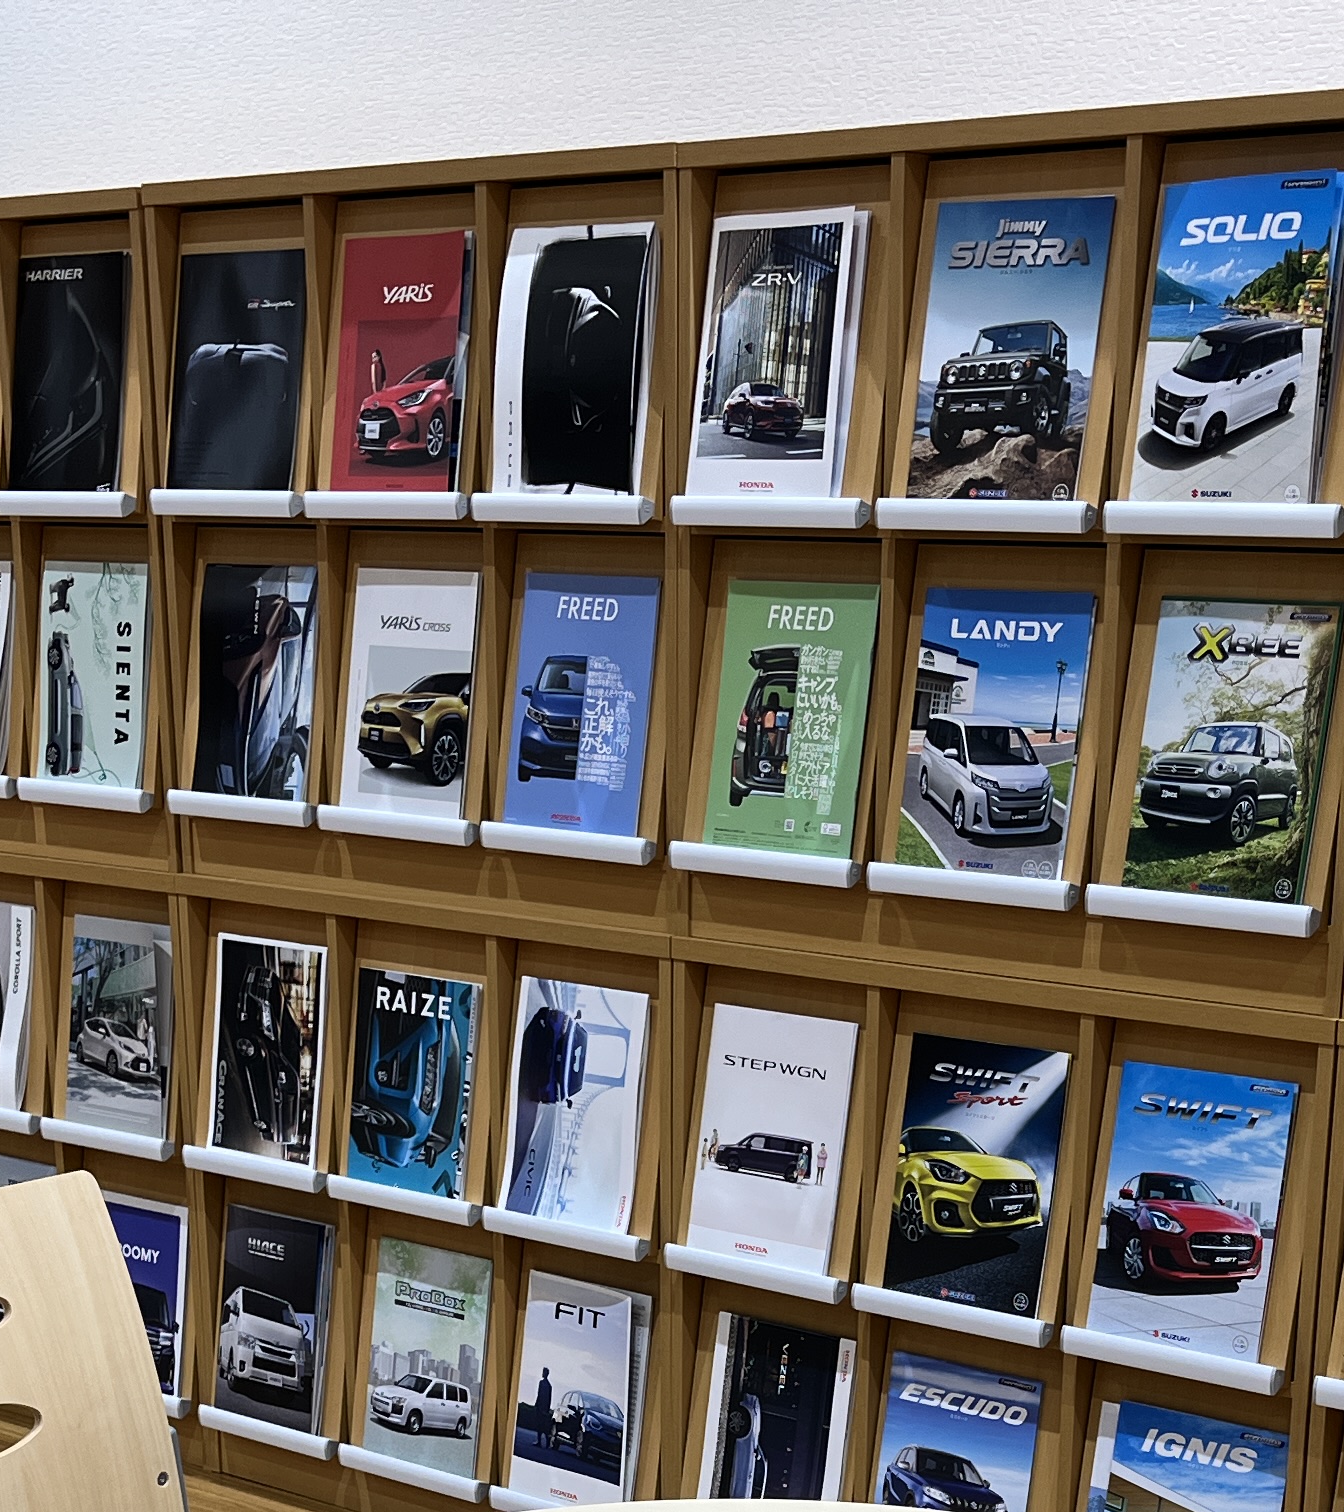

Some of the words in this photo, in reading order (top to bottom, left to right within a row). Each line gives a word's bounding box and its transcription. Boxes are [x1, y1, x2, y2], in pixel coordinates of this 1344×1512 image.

[1179, 211, 1302, 246] SOLIO
[948, 237, 1091, 269] SIERRA
[25, 268, 84, 282] HARRIER
[738, 481, 774, 489] HONDA
[1200, 490, 1232, 498] SUZUKI
[557, 596, 619, 621] FREED
[767, 605, 835, 632] FREED
[950, 618, 1064, 642] LANDY
[114, 621, 132, 745] SIENTA
[797, 674, 838, 693] キャンプ
[582, 715, 615, 736] 正解
[802, 709, 836, 726] めっちゃ
[580, 734, 611, 754] かも。
[965, 861, 994, 869] SUZUKI
[12, 950, 22, 995] COROLLA
[375, 986, 452, 1020] RAIZE
[929, 1062, 1041, 1093] SWIFT
[946, 1091, 1029, 1108] Sport
[1132, 1092, 1273, 1131] SWIFT
[523, 1148, 537, 1198] CIVIC
[119, 1243, 160, 1264] OOMY
[248, 1237, 286, 1257] HIACE
[734, 1242, 769, 1255] HONDA
[555, 1302, 606, 1328] FIT
[1160, 1332, 1191, 1343] SUZUKI
[898, 1382, 1029, 1427] ESCUDO
[1140, 1428, 1259, 1475] IGNIS
[549, 1487, 579, 1500] HONDA
